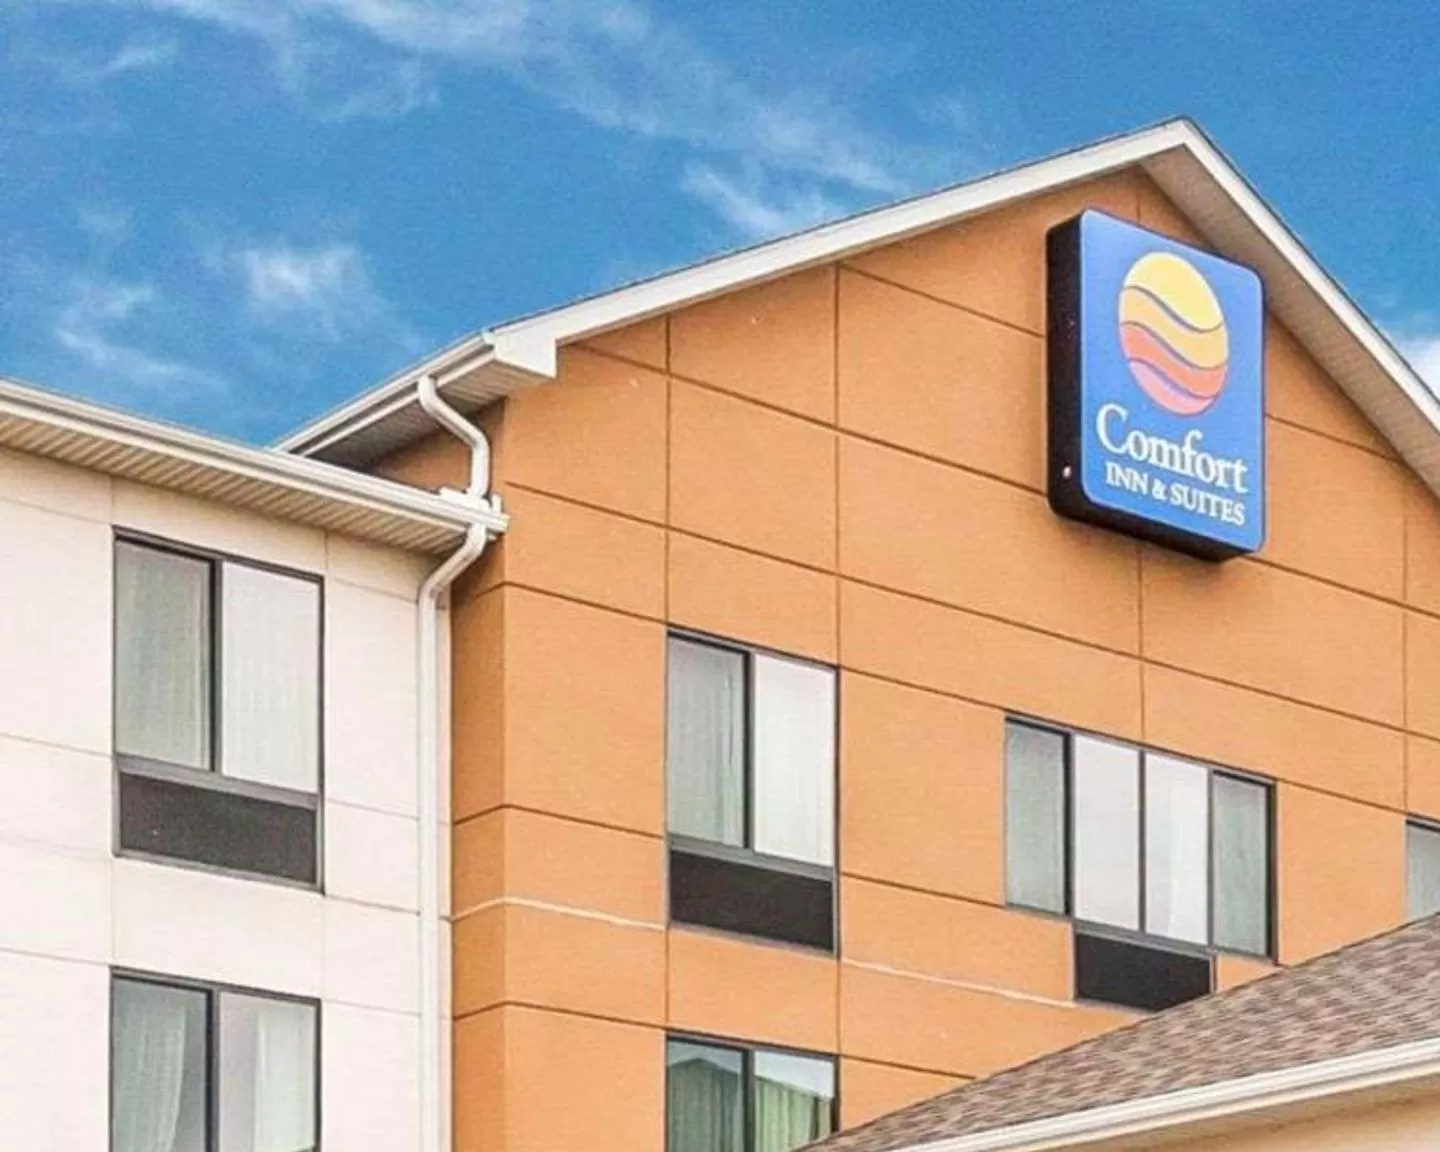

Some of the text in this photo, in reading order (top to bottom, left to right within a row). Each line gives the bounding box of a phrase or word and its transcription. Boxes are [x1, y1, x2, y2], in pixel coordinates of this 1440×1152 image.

[1096, 403, 1248, 493] Comfort
[1105, 461, 1245, 525] INN & SUITES
